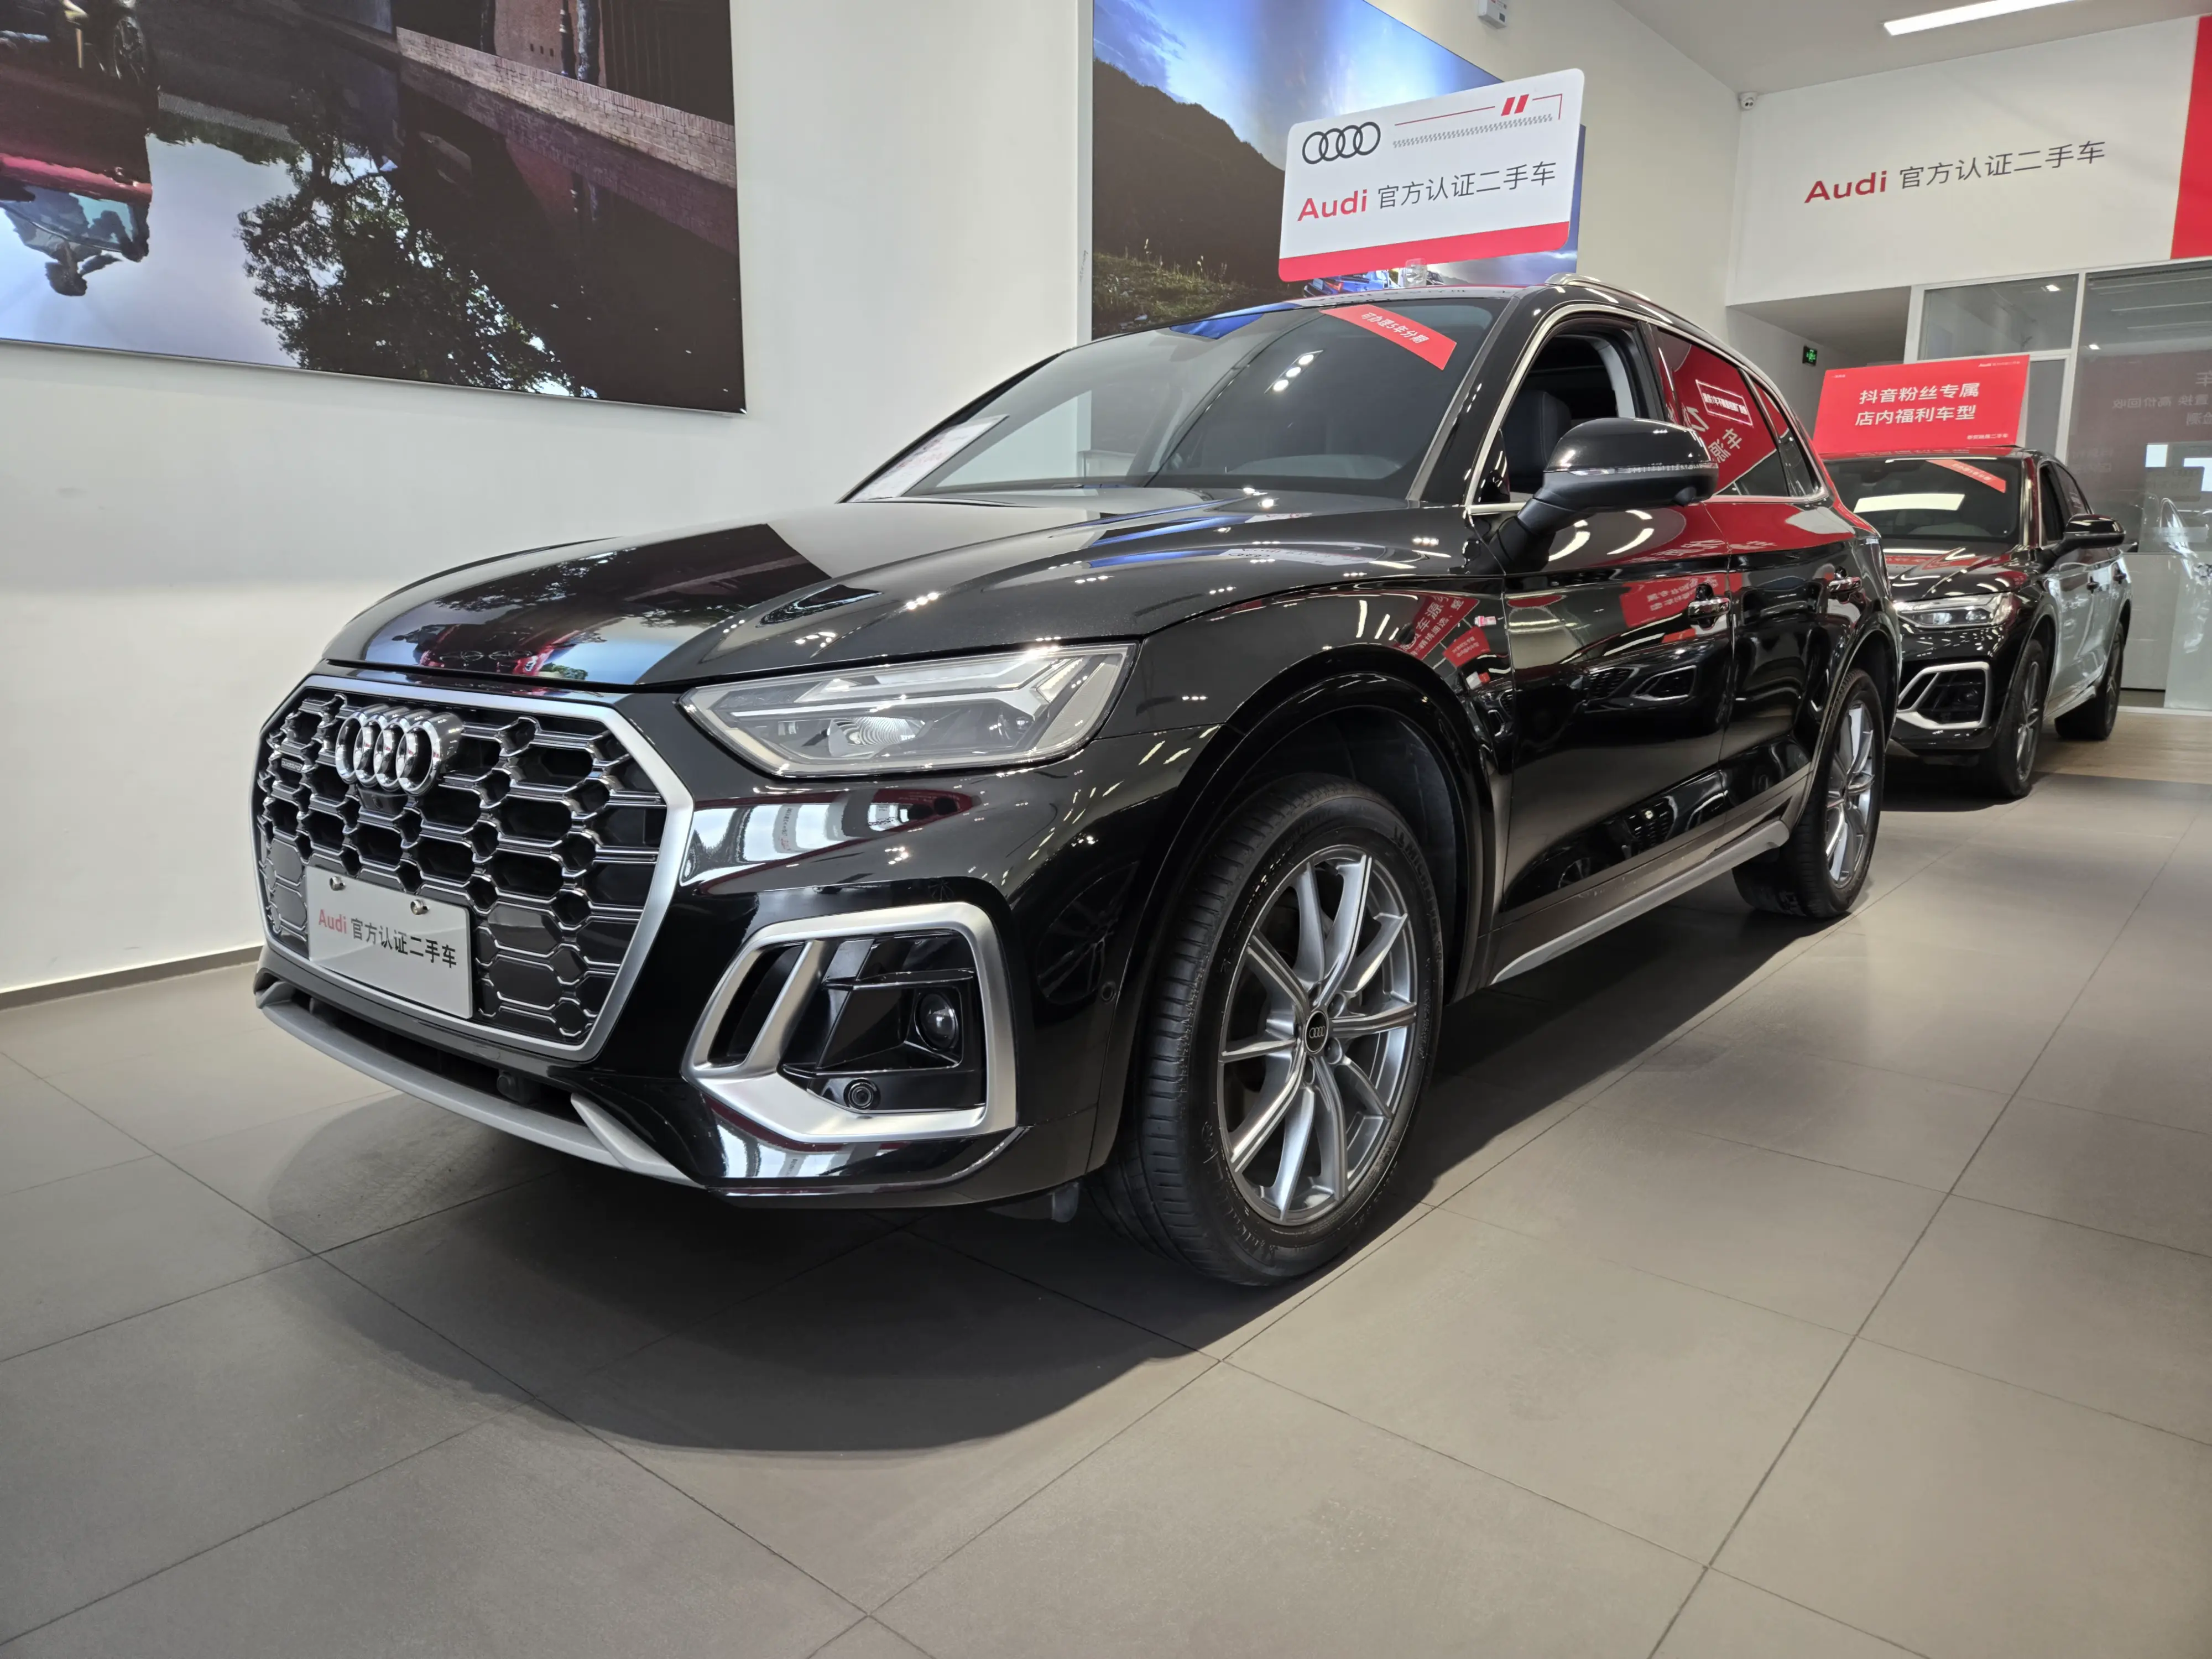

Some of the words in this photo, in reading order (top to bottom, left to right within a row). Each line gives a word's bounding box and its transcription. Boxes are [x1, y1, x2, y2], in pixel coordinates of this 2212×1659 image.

[1297, 189, 1368, 221] Audi
[1378, 161, 1556, 210] 官方认证二手车
[1804, 170, 1887, 204] Audi
[1899, 140, 2106, 190] 官方认证二手车
[1361, 311, 1430, 344] 可办理5年分期
[1855, 404, 1976, 426] 店内福利车型
[1859, 383, 1980, 405] 抖音粉丝专属
[319, 909, 347, 934] Audi
[351, 917, 457, 968] 官方认证二手车
